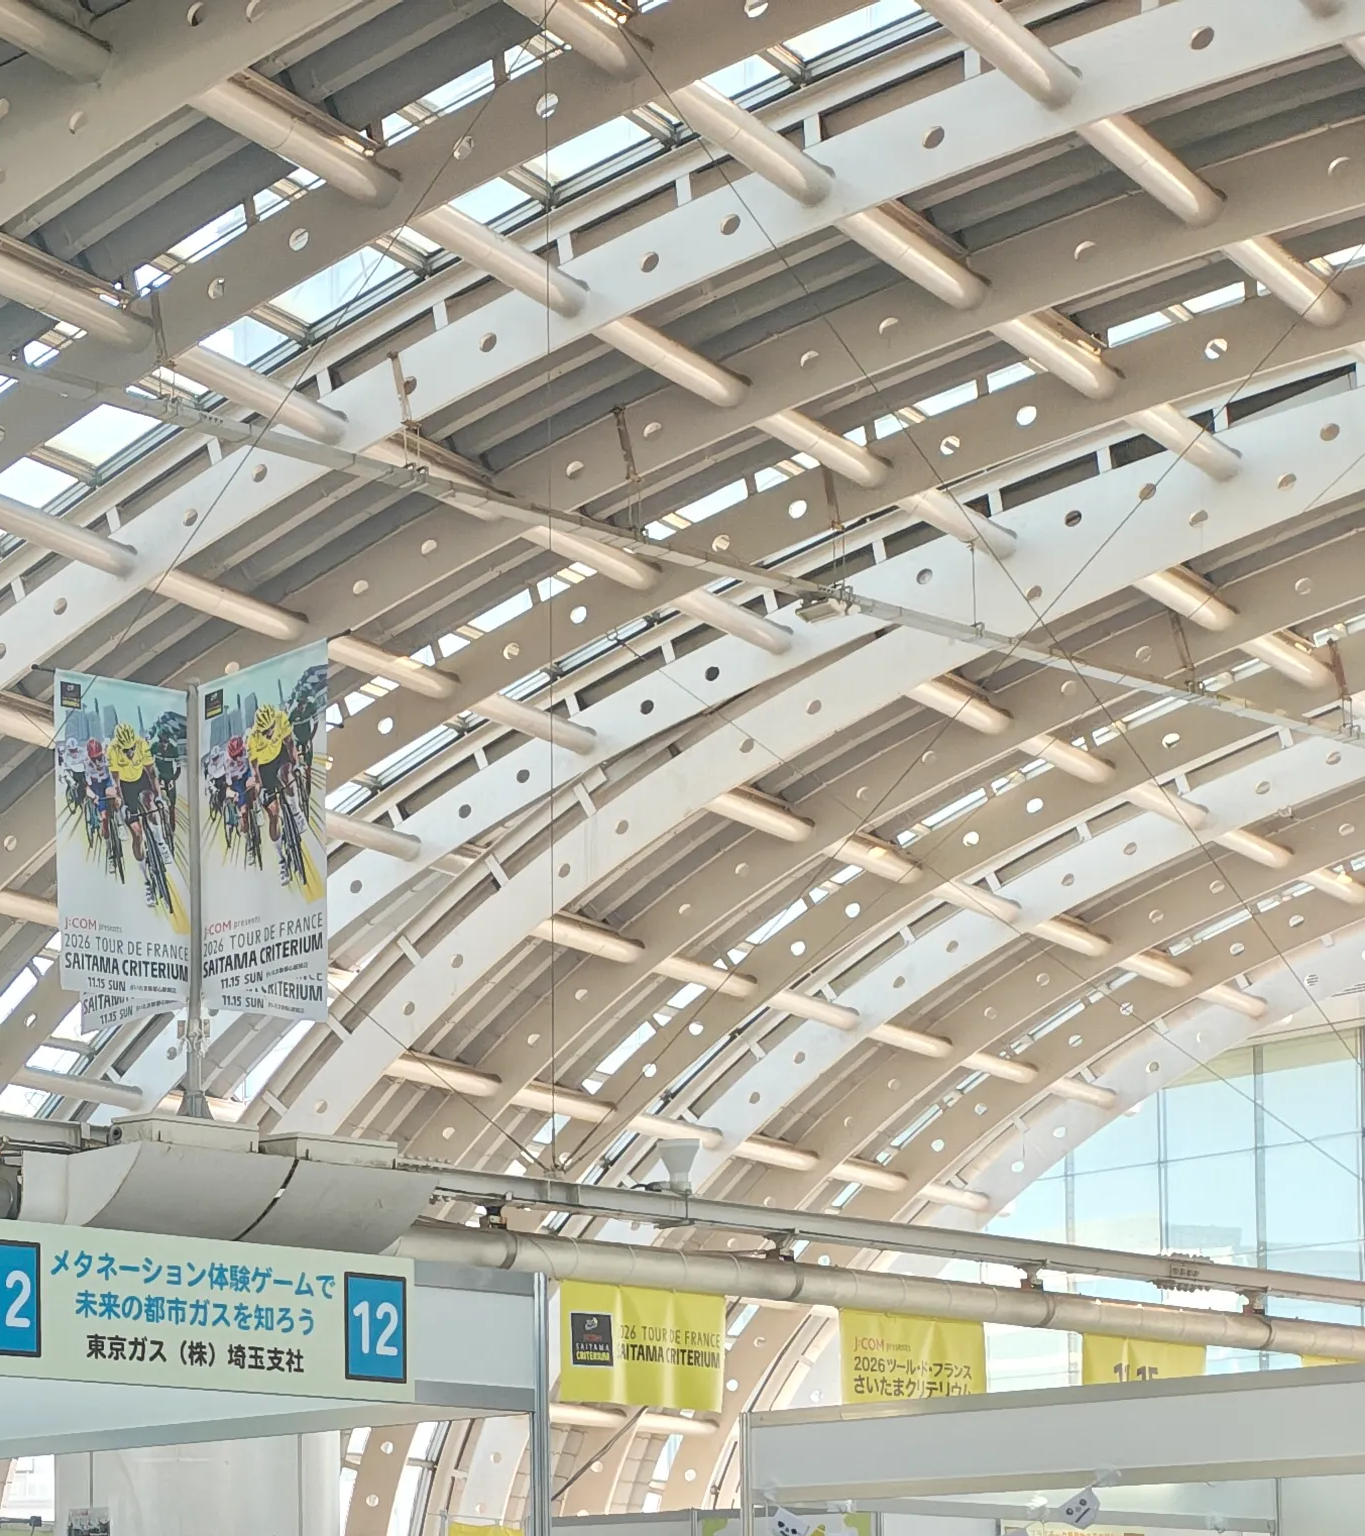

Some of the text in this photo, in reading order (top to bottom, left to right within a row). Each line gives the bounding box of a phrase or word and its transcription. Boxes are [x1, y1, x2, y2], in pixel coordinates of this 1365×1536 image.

[64, 933, 189, 961] 2026 TOUR DE FRANCE
[203, 912, 323, 957] 2026 TOUR DE FRANCE
[65, 952, 188, 982] SAITAMA CRITERIUM
[203, 950, 258, 978] SAITAMA
[260, 931, 323, 965] CRITERIUM
[88, 977, 105, 989] 11.15
[108, 979, 126, 991] SUN
[221, 971, 263, 989] 11.15 SUN
[222, 995, 242, 1006] 11.15
[245, 996, 264, 1008] SUN
[100, 1011, 117, 1024] 11.15
[119, 1005, 133, 1019] SUN
[50, 1249, 336, 1300] メタネーション体験ゲームで
[74, 1290, 315, 1336] 未来の都市ガスを知ろう
[352, 1301, 398, 1357] 12
[642, 1326, 667, 1343] TOUR
[669, 1330, 681, 1343] DE
[684, 1331, 720, 1348] FRANCE
[576, 1351, 610, 1361] CRITERIUM
[666, 1348, 720, 1368] CRITERIUM
